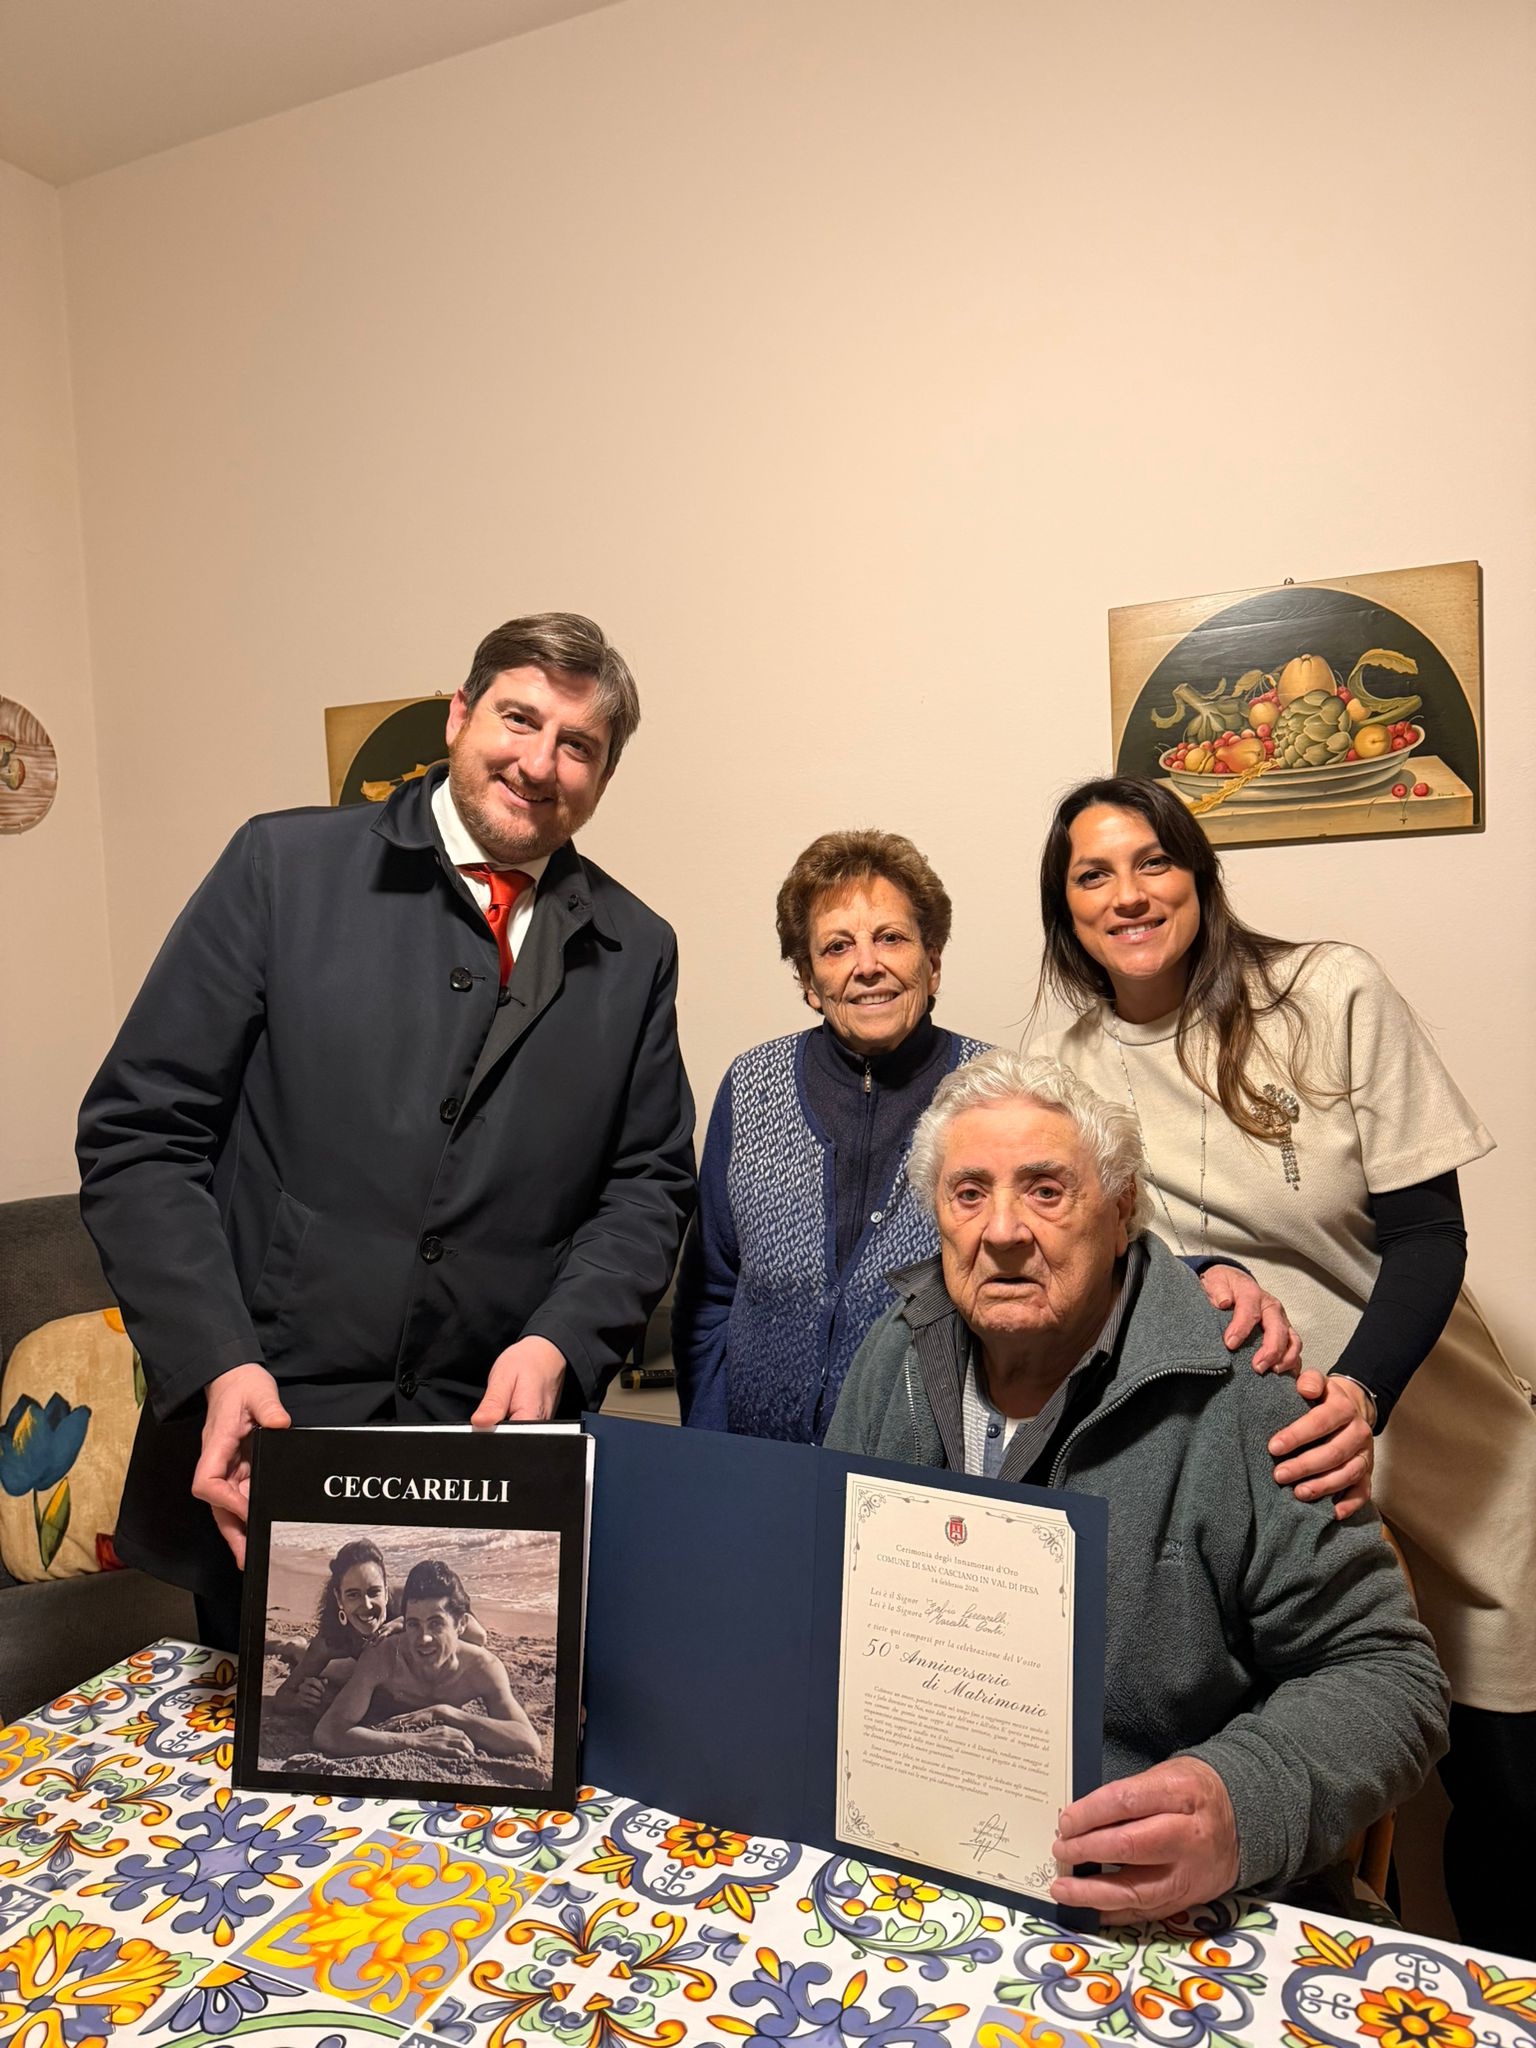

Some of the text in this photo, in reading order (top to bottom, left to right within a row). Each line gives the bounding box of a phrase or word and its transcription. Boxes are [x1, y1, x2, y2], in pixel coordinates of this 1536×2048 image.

[323, 1475, 510, 1503] CECCARELLI
[877, 1554, 1039, 1596] COMUNE DI SAN CASCIANO IN VAL DI PESA
[895, 1544, 1019, 1577] Cerimonia degli Innamorati d'Oro
[869, 1599, 880, 1608] Lei
[896, 1605, 922, 1618] Signora
[871, 1587, 882, 1597] Lei
[896, 1593, 919, 1605] Signor
[900, 1650, 1010, 1688] Anniversario
[934, 1639, 946, 1647] per
[957, 1644, 1000, 1660] celebrazione
[1002, 1653, 1014, 1663] del
[1017, 1656, 1041, 1669] Vostro
[922, 1673, 941, 1691] di
[944, 1681, 1048, 1718] Matrimonio
